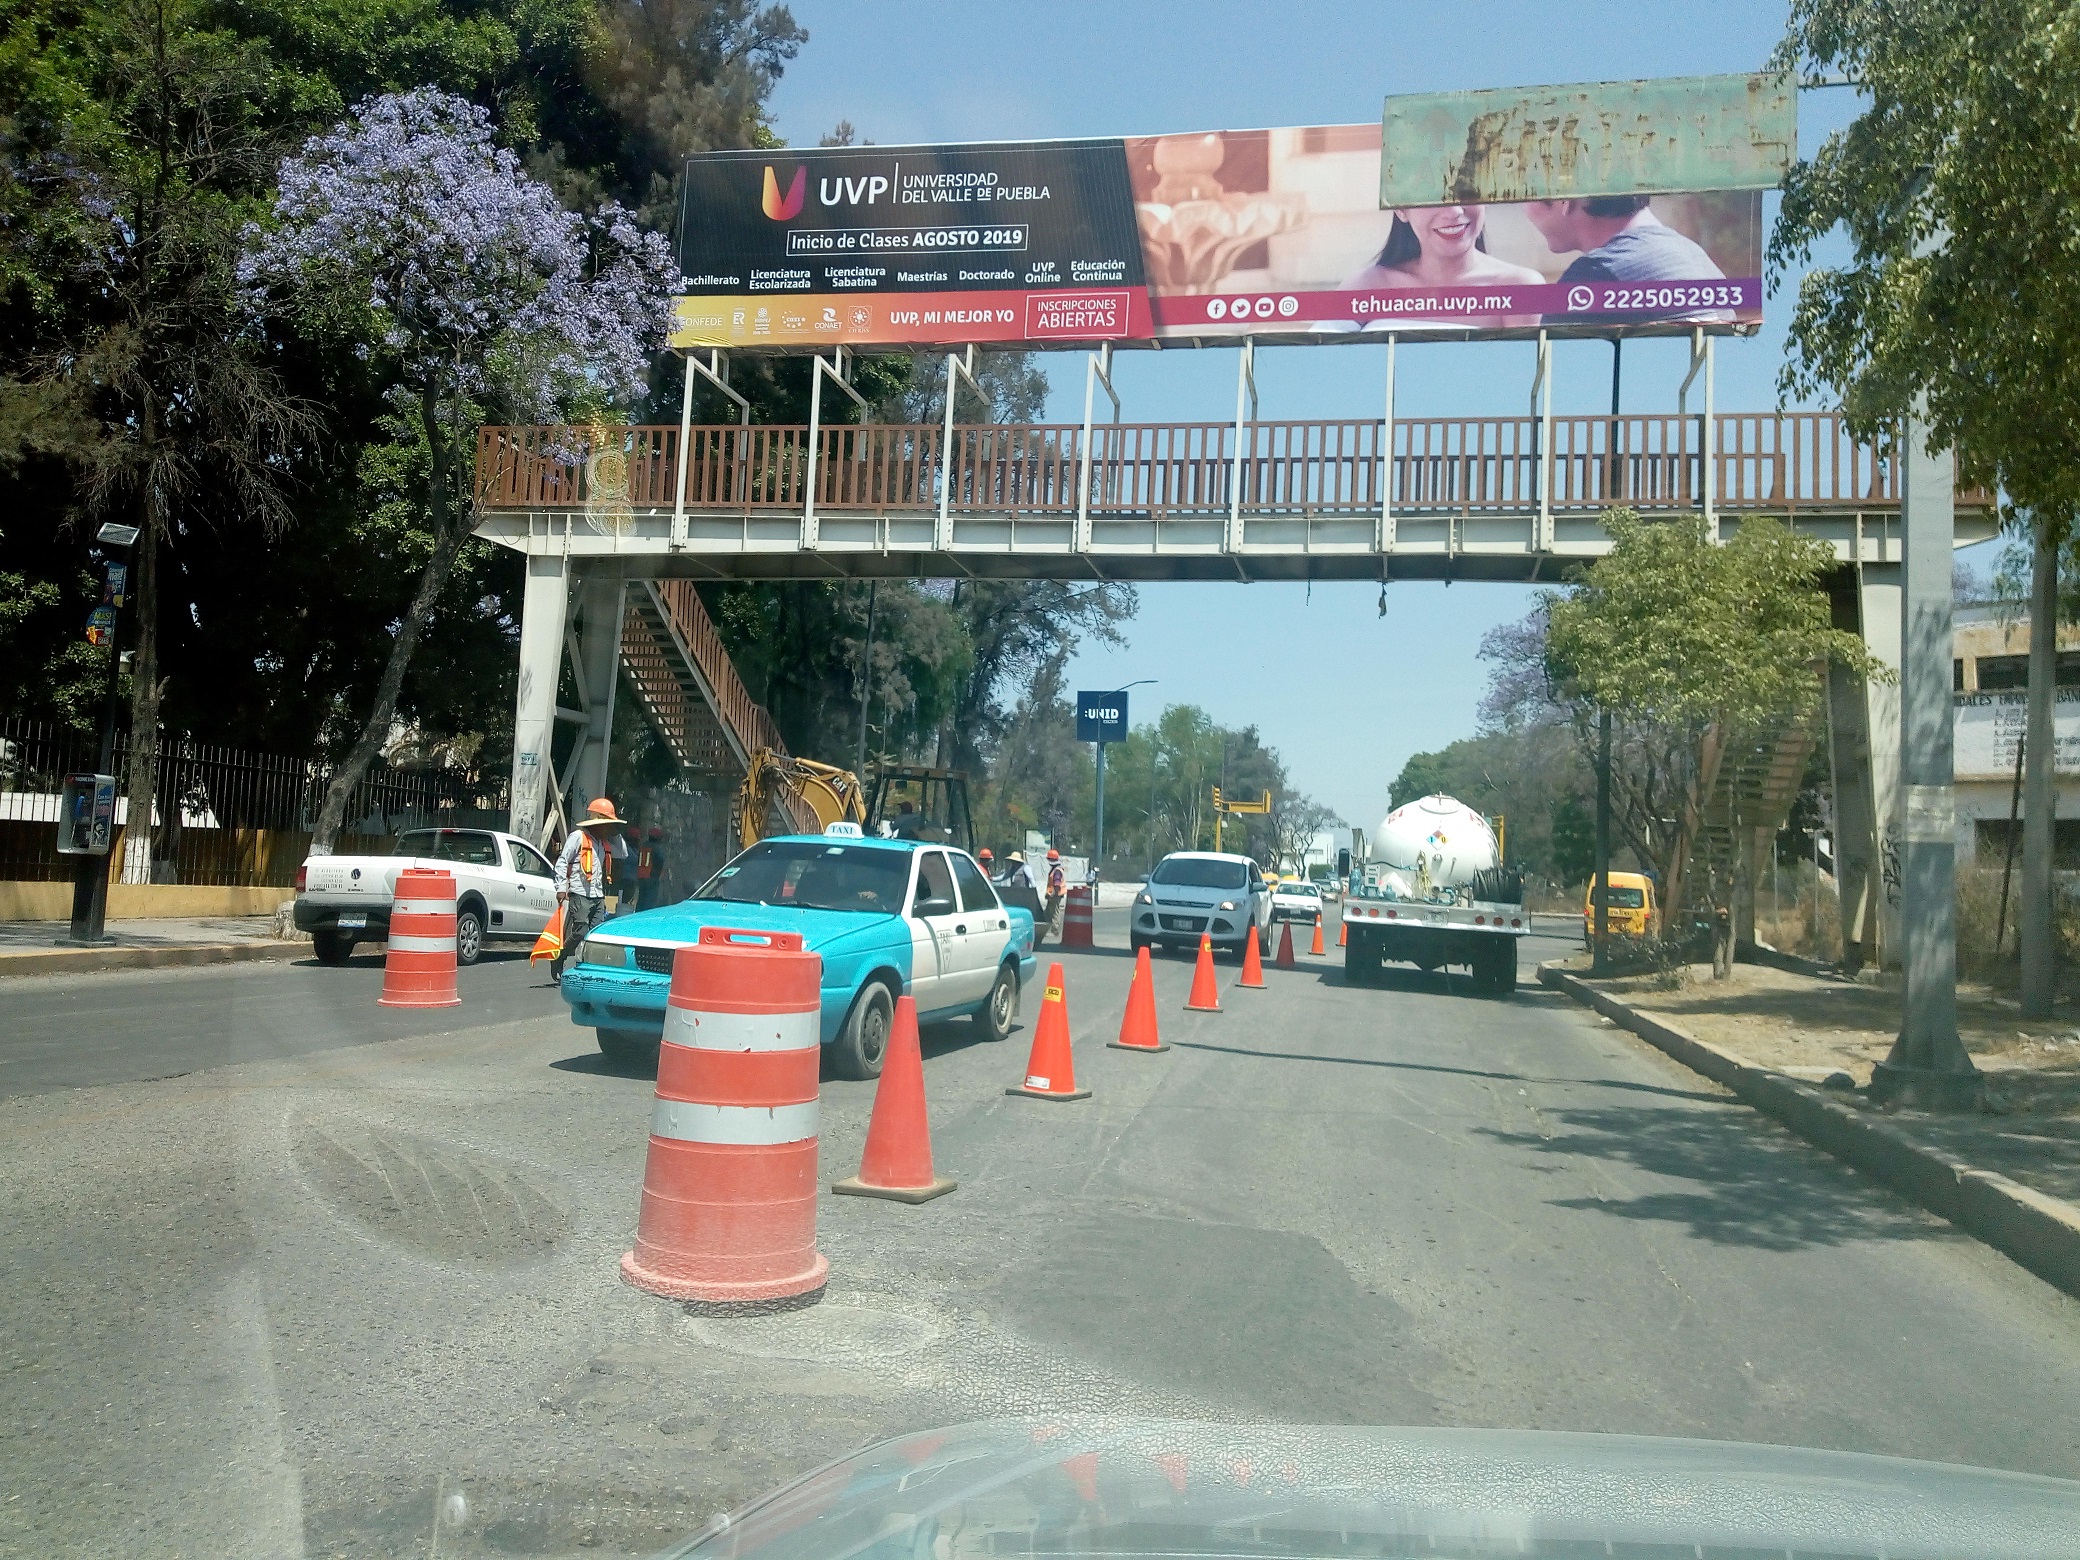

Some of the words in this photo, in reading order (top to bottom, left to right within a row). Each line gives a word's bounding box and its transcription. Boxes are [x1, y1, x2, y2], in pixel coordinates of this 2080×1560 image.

[903, 172, 998, 188] UNIVERSIDAD
[819, 176, 889, 206] UVP
[902, 190, 928, 204] DEL
[931, 188, 972, 203] VALLE
[977, 187, 992, 200] DE
[996, 186, 1051, 201] PUEBLA
[791, 234, 833, 249] Inicio
[837, 233, 855, 249] de
[859, 232, 909, 248] Clases
[912, 230, 979, 247] AGOSTO
[983, 229, 1022, 245] 2019
[1032, 261, 1056, 273] UVP
[1071, 259, 1126, 271] Educación
[750, 268, 811, 279] Licenciatura
[825, 266, 886, 277] Licenciatura
[897, 270, 948, 282] Maestrías
[959, 269, 1015, 281] Doctorado
[1072, 269, 1123, 282] Continua
[681, 274, 740, 286] Bachillerato
[832, 276, 877, 288] Sabatina
[1025, 272, 1061, 284] Online
[749, 279, 811, 290] Escolarizada
[1350, 294, 1512, 314] tehuacan.uvp.mx
[1603, 287, 1743, 309] 2225052933
[1037, 299, 1117, 312] INSCRIPCIONES
[890, 311, 920, 327] UVP,
[924, 311, 941, 324] MI
[944, 310, 993, 323] MEJOR
[995, 309, 1014, 322] YO
[1037, 311, 1116, 329] ABIERTAS
[832, 777, 848, 793] CAT
[831, 825, 854, 835] TAXI
